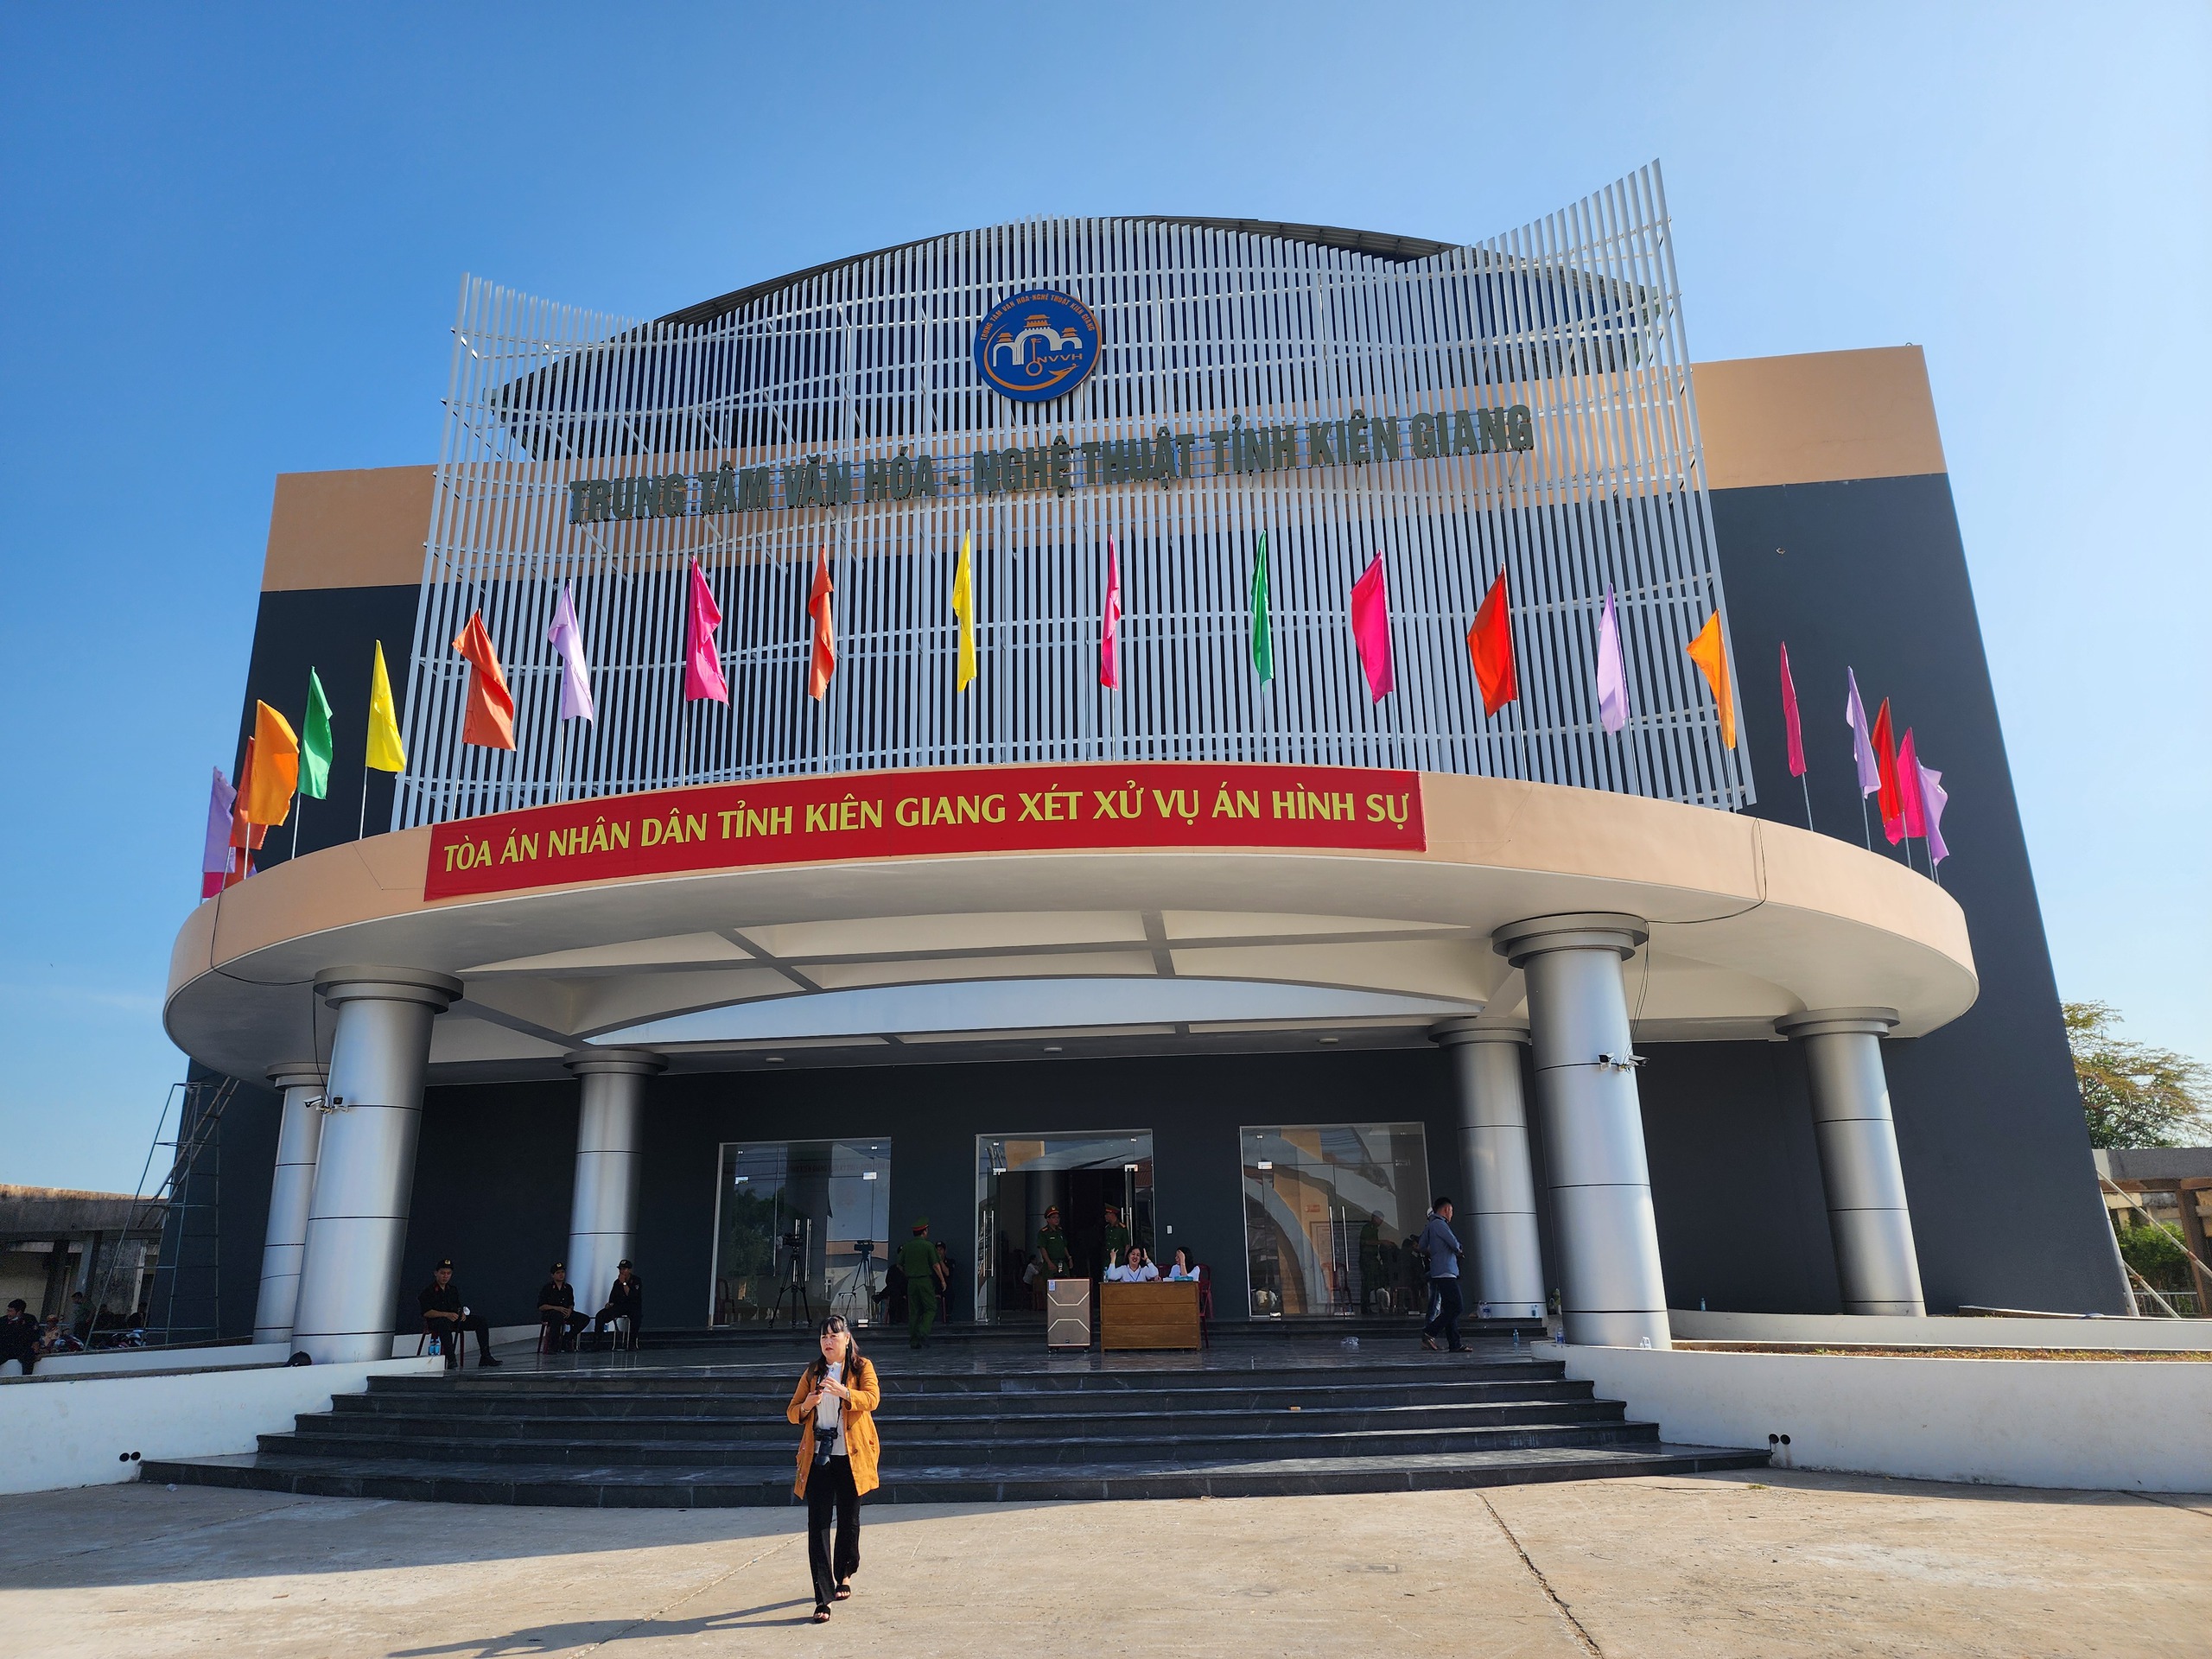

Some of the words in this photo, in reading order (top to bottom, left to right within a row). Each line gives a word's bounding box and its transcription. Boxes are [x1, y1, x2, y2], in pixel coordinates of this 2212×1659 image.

[569, 474, 687, 524] TRUNG
[696, 461, 771, 512] TÂM
[783, 454, 852, 507] VĂN
[864, 447, 937, 502] HÓA
[947, 475, 960, 487] -
[973, 435, 1070, 498] NGHỆ
[1081, 426, 1195, 490] THUẬT
[1210, 414, 1295, 474] TỈNH
[1309, 409, 1399, 467] KIÊN
[1412, 404, 1535, 459] GIANG
[443, 840, 493, 872] TÒA
[499, 832, 539, 865] ÁN
[547, 817, 631, 858] NHÂN
[640, 807, 708, 847] DÂN
[717, 800, 793, 839] TỈNH
[805, 794, 883, 833] KIÊN
[895, 793, 1006, 827] GIANG
[1019, 783, 1084, 822] XÉT
[1092, 780, 1145, 820] XỬ
[1152, 789, 1199, 826] VỤ
[1211, 781, 1260, 818] ÁN
[1272, 782, 1356, 821] HÌNH
[1365, 792, 1409, 830] SỰ
